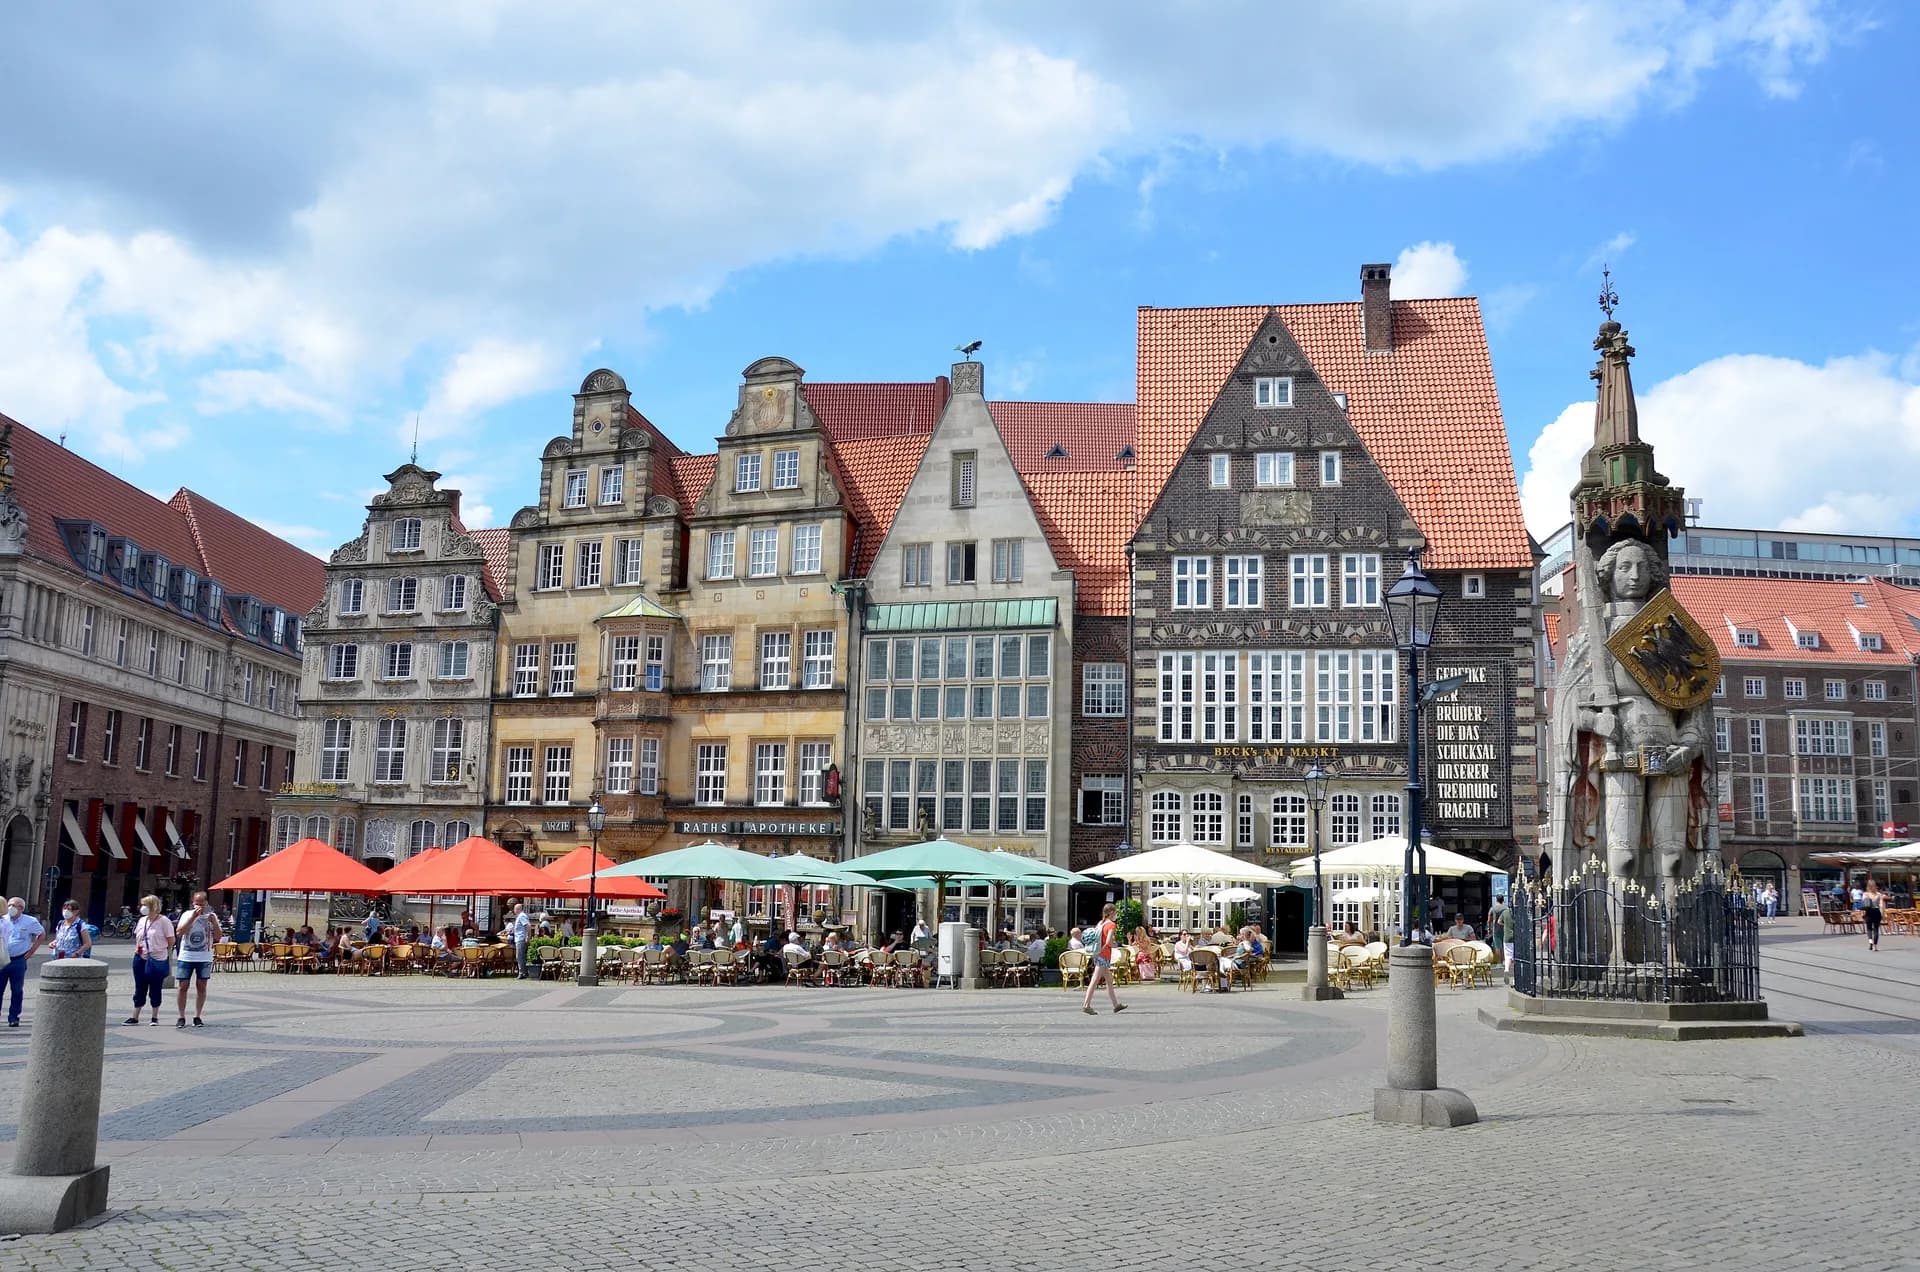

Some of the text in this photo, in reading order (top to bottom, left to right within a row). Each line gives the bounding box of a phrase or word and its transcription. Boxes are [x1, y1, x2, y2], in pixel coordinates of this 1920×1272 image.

[1436, 703, 1488, 722] BRÜDER,
[1437, 725, 1480, 741] DIE DAS
[1214, 747, 1340, 757] BECK's AM MARKT
[1437, 744, 1497, 760] SCHICKSAL
[1437, 764, 1489, 780] UNSERER
[1437, 783, 1498, 799] TRENNUNG
[1437, 803, 1481, 819] TRAGEN
[683, 822, 826, 833] RATHS APOTHEKE
